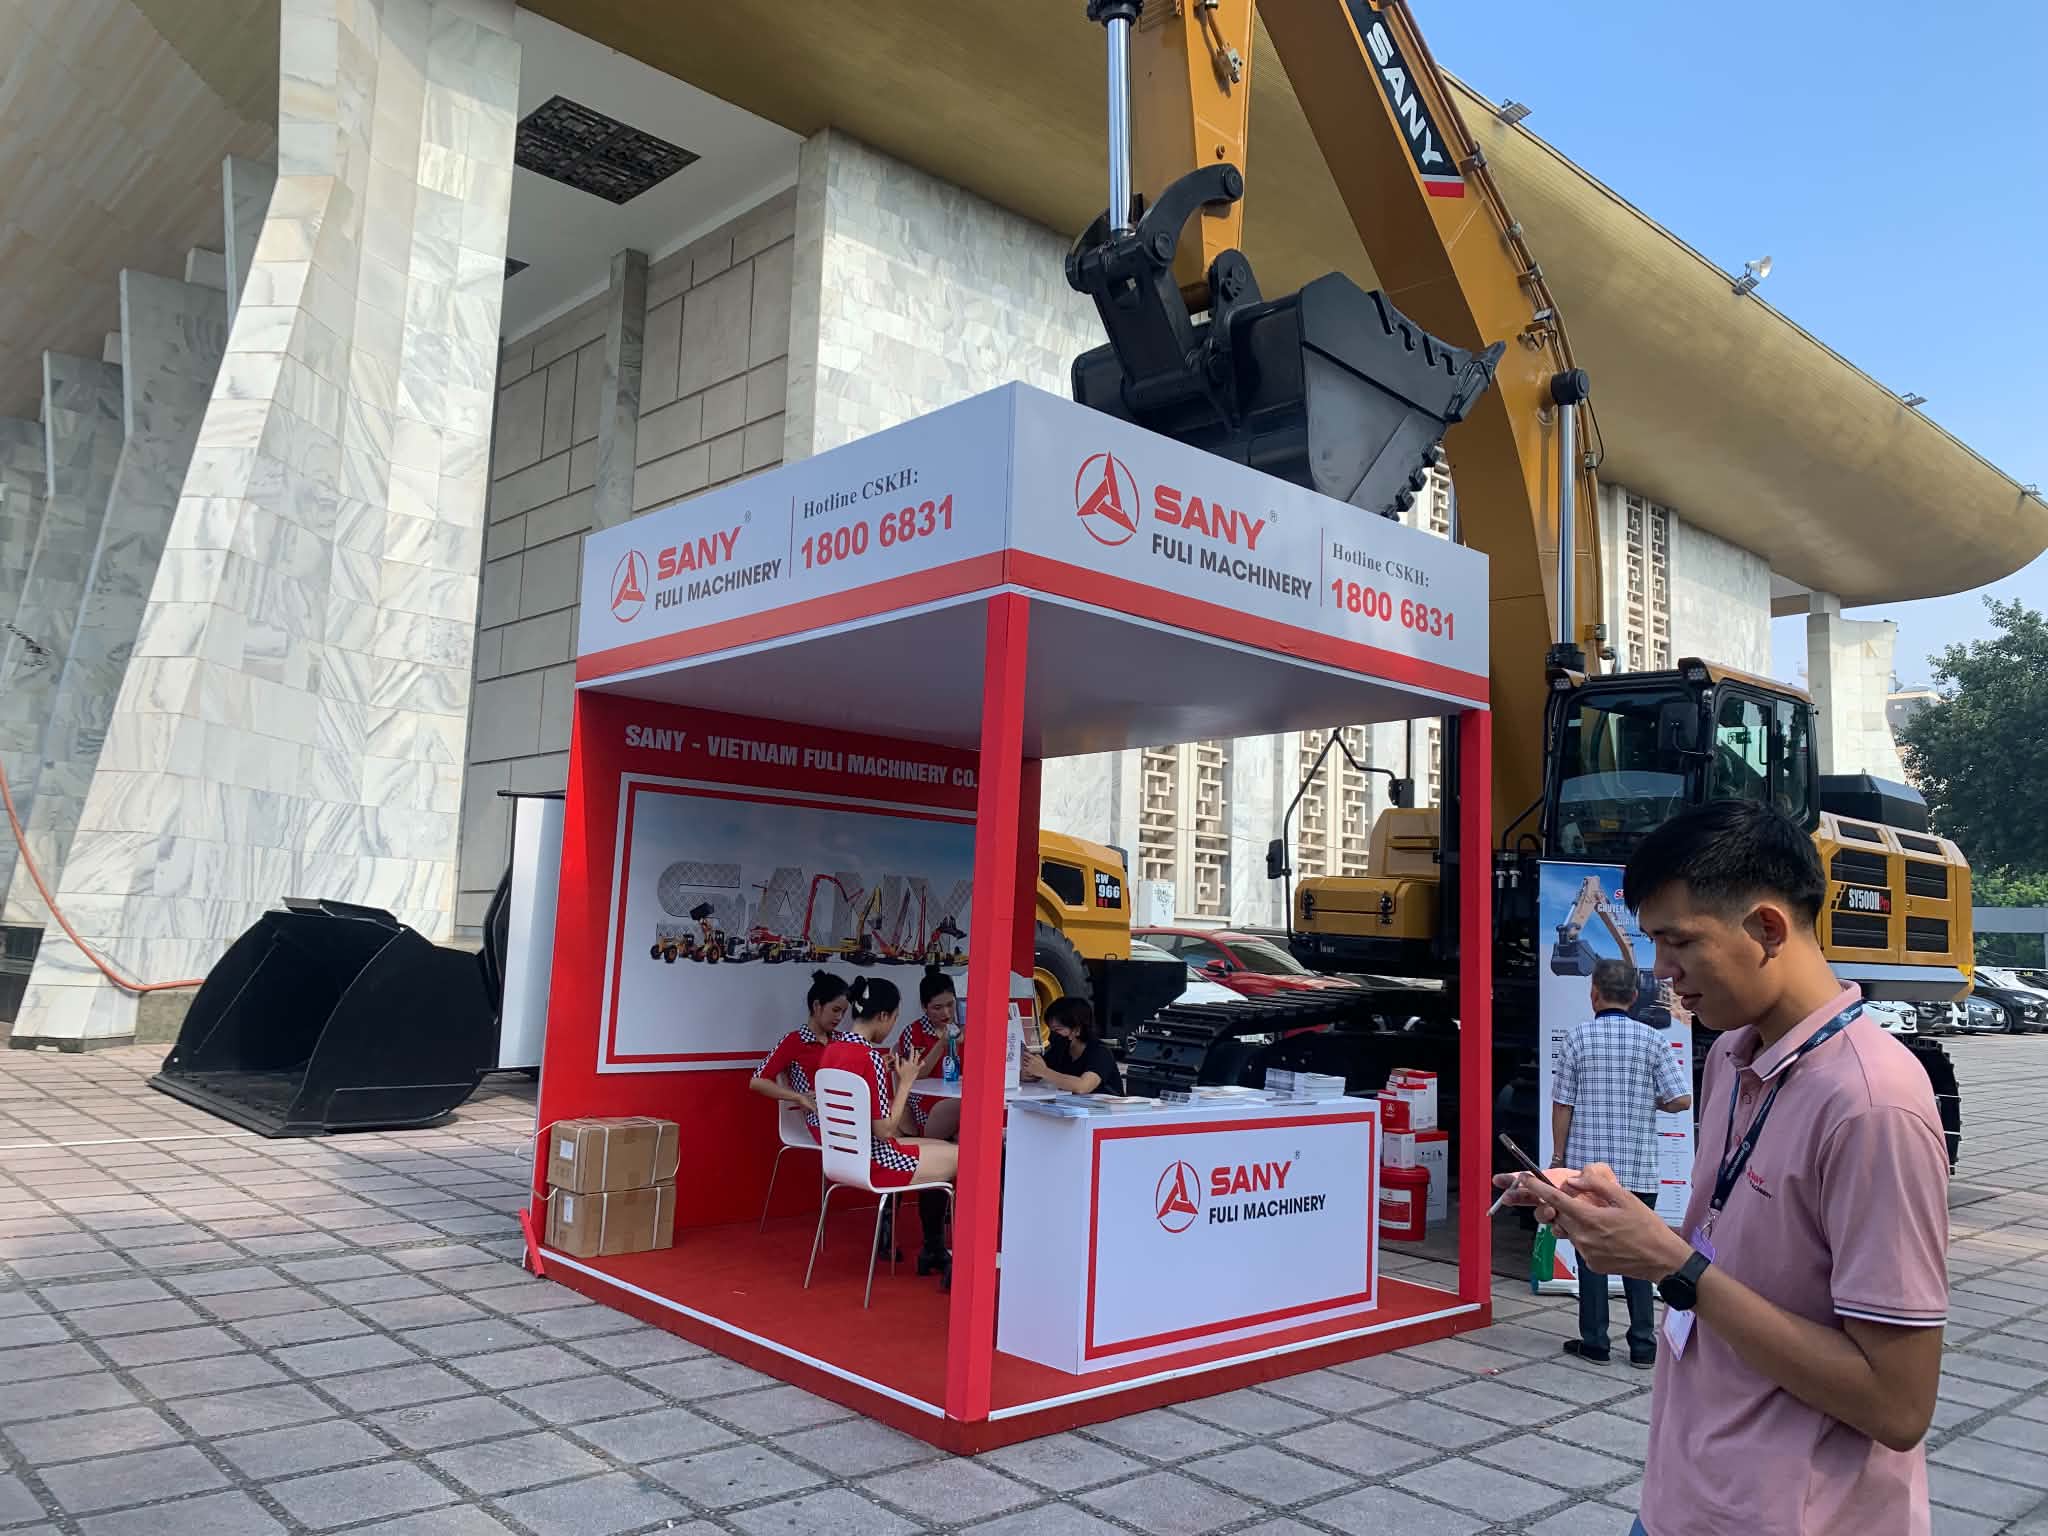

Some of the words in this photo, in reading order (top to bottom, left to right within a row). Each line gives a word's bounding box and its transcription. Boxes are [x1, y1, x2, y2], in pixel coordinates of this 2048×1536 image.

[1366, 22, 1444, 165] SANY
[803, 489, 858, 519] Hotline
[862, 467, 919, 501] CSKH:
[1154, 484, 1266, 551] SANY
[656, 525, 743, 581] SANY
[801, 520, 870, 569] 1800
[879, 494, 954, 548] 6831
[655, 586, 685, 611] FULI
[687, 558, 783, 600] MACHINERY
[1152, 534, 1193, 566] FULI
[1200, 547, 1313, 601] MACHINERY
[1332, 542, 1382, 573] Hotline
[1385, 558, 1430, 588] CSKH:
[1331, 578, 1393, 622] 1800
[1400, 597, 1455, 641] 6831
[625, 724, 686, 753] SANY
[707, 735, 799, 767] VIETNAM
[803, 748, 843, 772] FULI
[847, 754, 950, 786] MACHINERY
[1098, 884, 1121, 898] 966
[1210, 1160, 1292, 1197] SANY
[1208, 1199, 1239, 1225] FULI
[1242, 1194, 1327, 1222] MACHINERY
